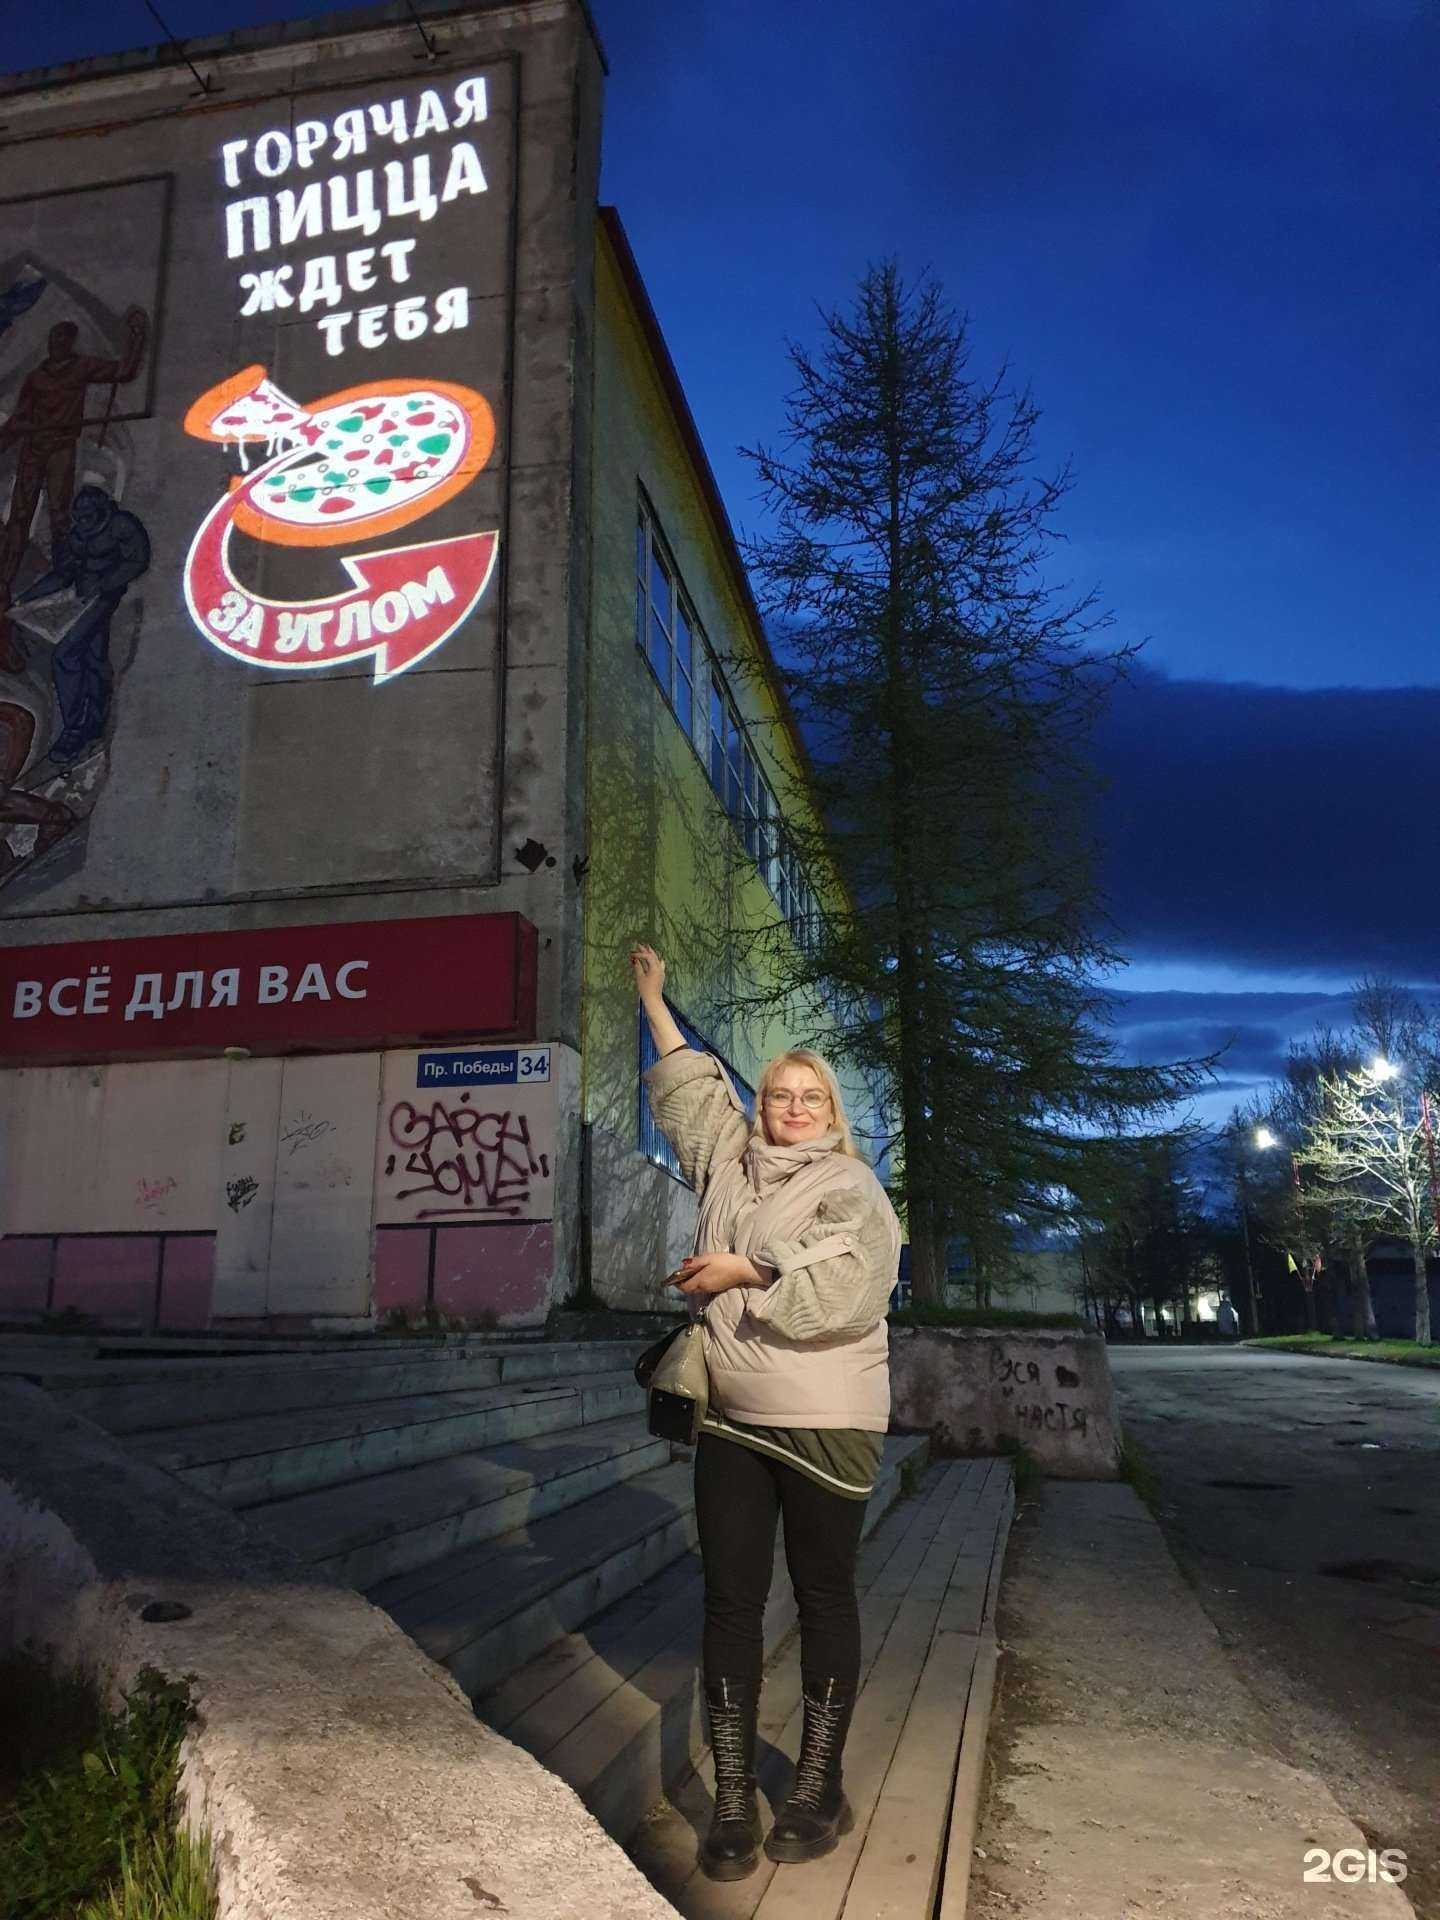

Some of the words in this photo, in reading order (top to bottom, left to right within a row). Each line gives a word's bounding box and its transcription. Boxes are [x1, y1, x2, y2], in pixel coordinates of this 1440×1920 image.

[222, 77, 489, 188] ГОРЯЧАЯ
[225, 142, 489, 258] ПИЦЦА
[239, 238, 417, 317] ЖДЕТ
[317, 287, 470, 356] ТЕБЯ
[207, 590, 265, 648] ЗА
[273, 565, 456, 653] УГЛОМ
[13, 965, 112, 1019] ВСЁ
[124, 967, 241, 1021] ДЛЯ
[258, 960, 369, 1005] ВАС
[424, 1062, 448, 1078] Пр.
[452, 1060, 514, 1075] Победы
[520, 1055, 547, 1076] 34
[1013, 1402, 1089, 1438] НАСТЯ
